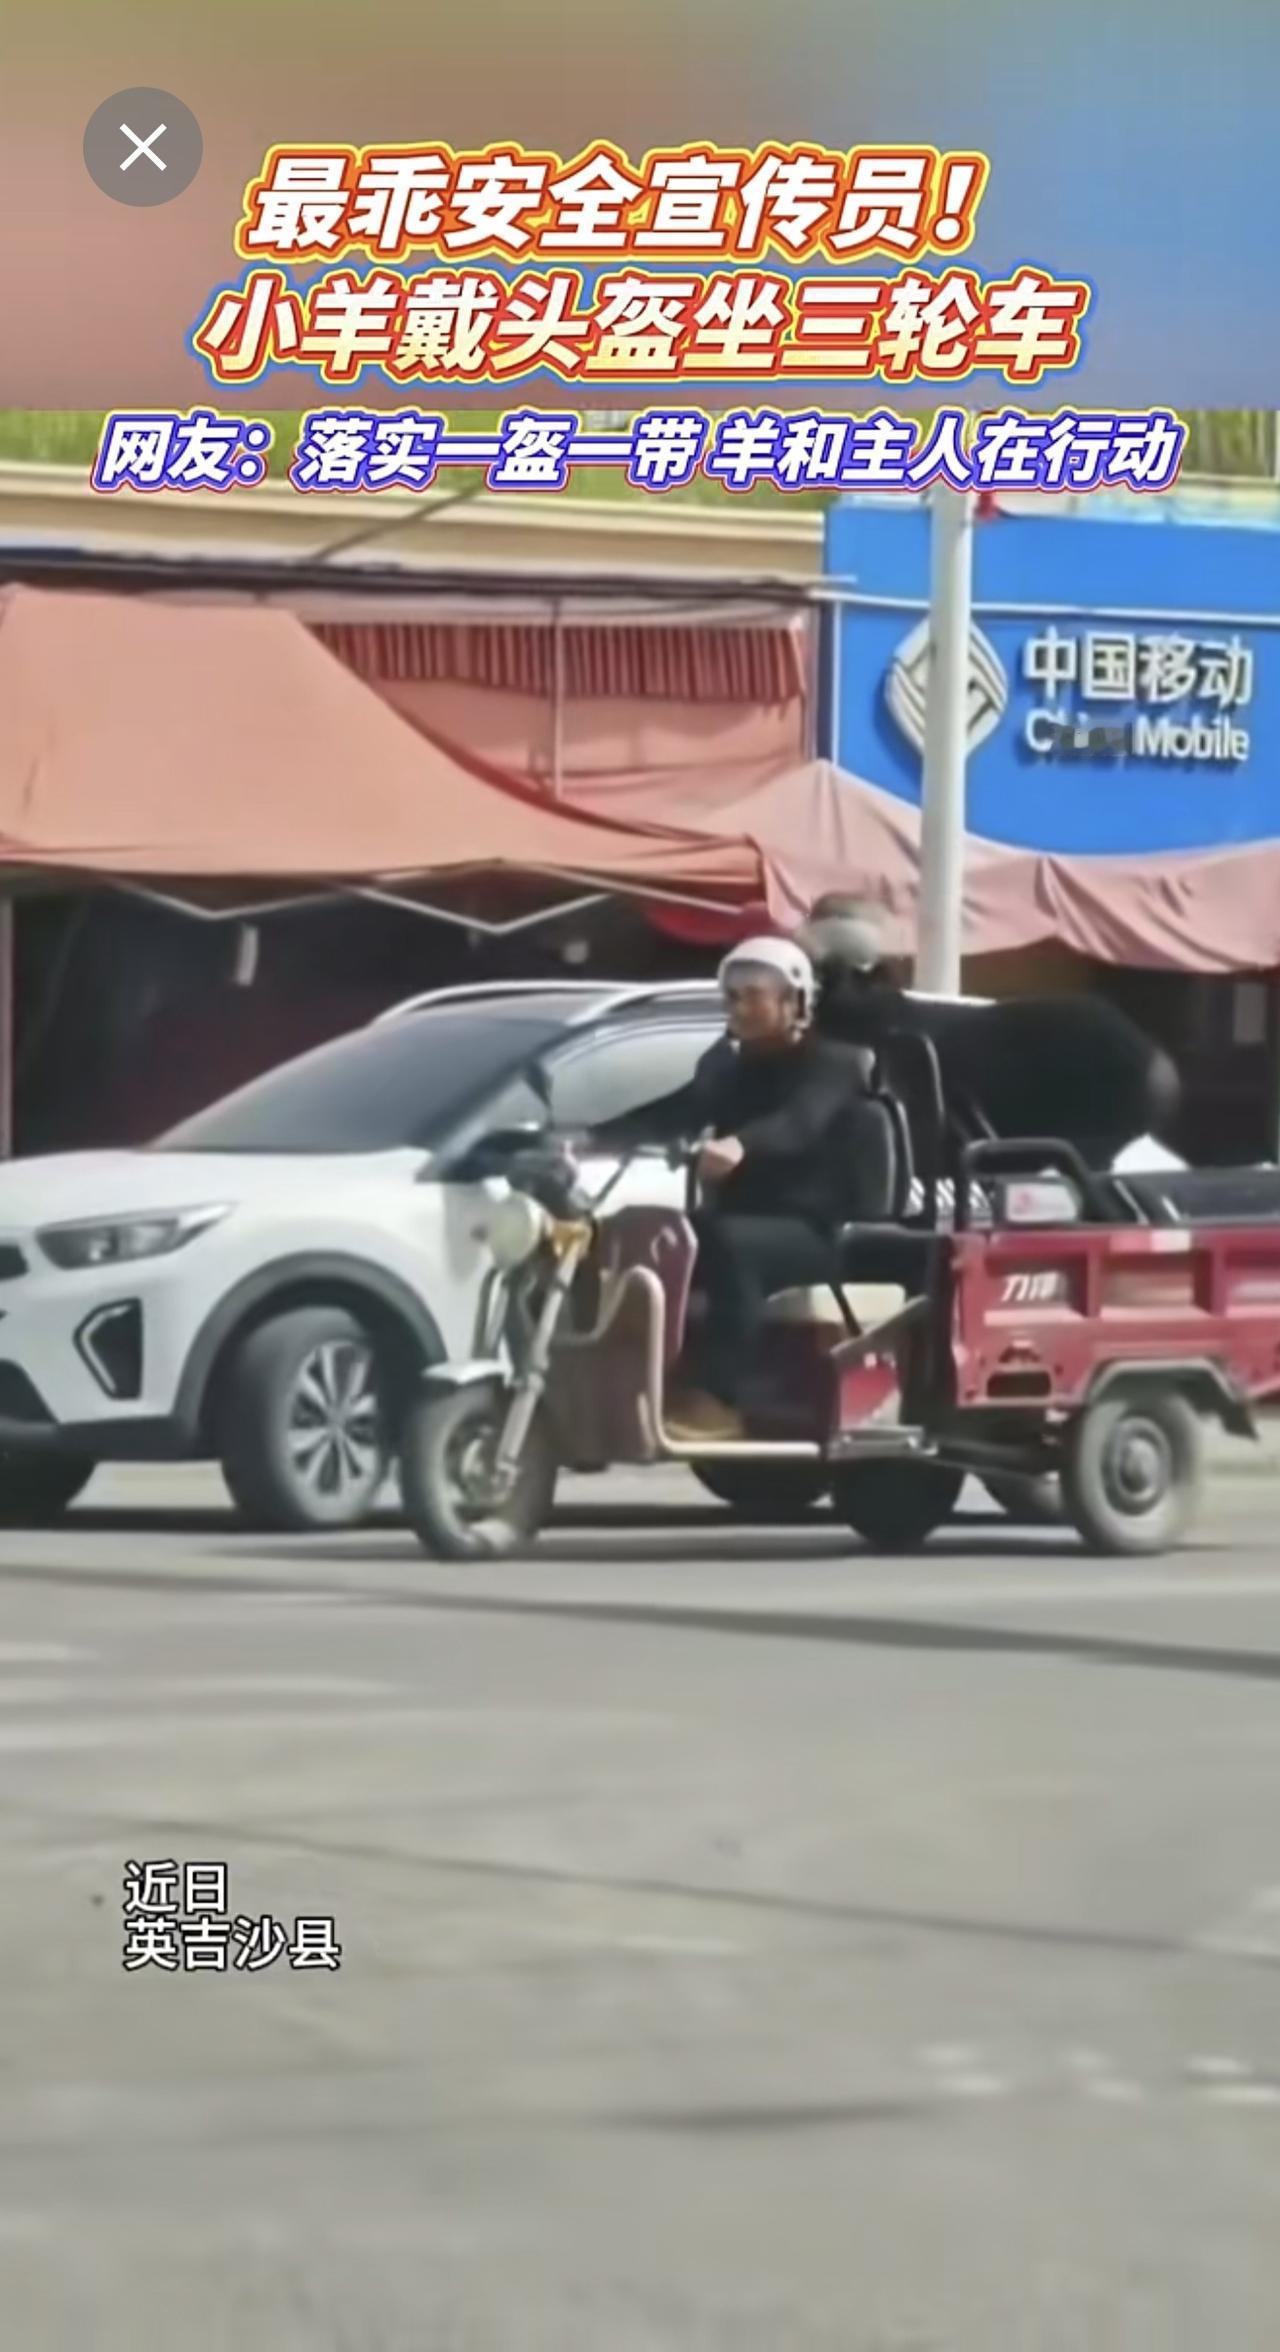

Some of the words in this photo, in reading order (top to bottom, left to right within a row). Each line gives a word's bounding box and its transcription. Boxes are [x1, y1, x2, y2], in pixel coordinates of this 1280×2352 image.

[1023, 624, 1254, 707] 中国移动
[1133, 714, 1250, 761] Mobile
